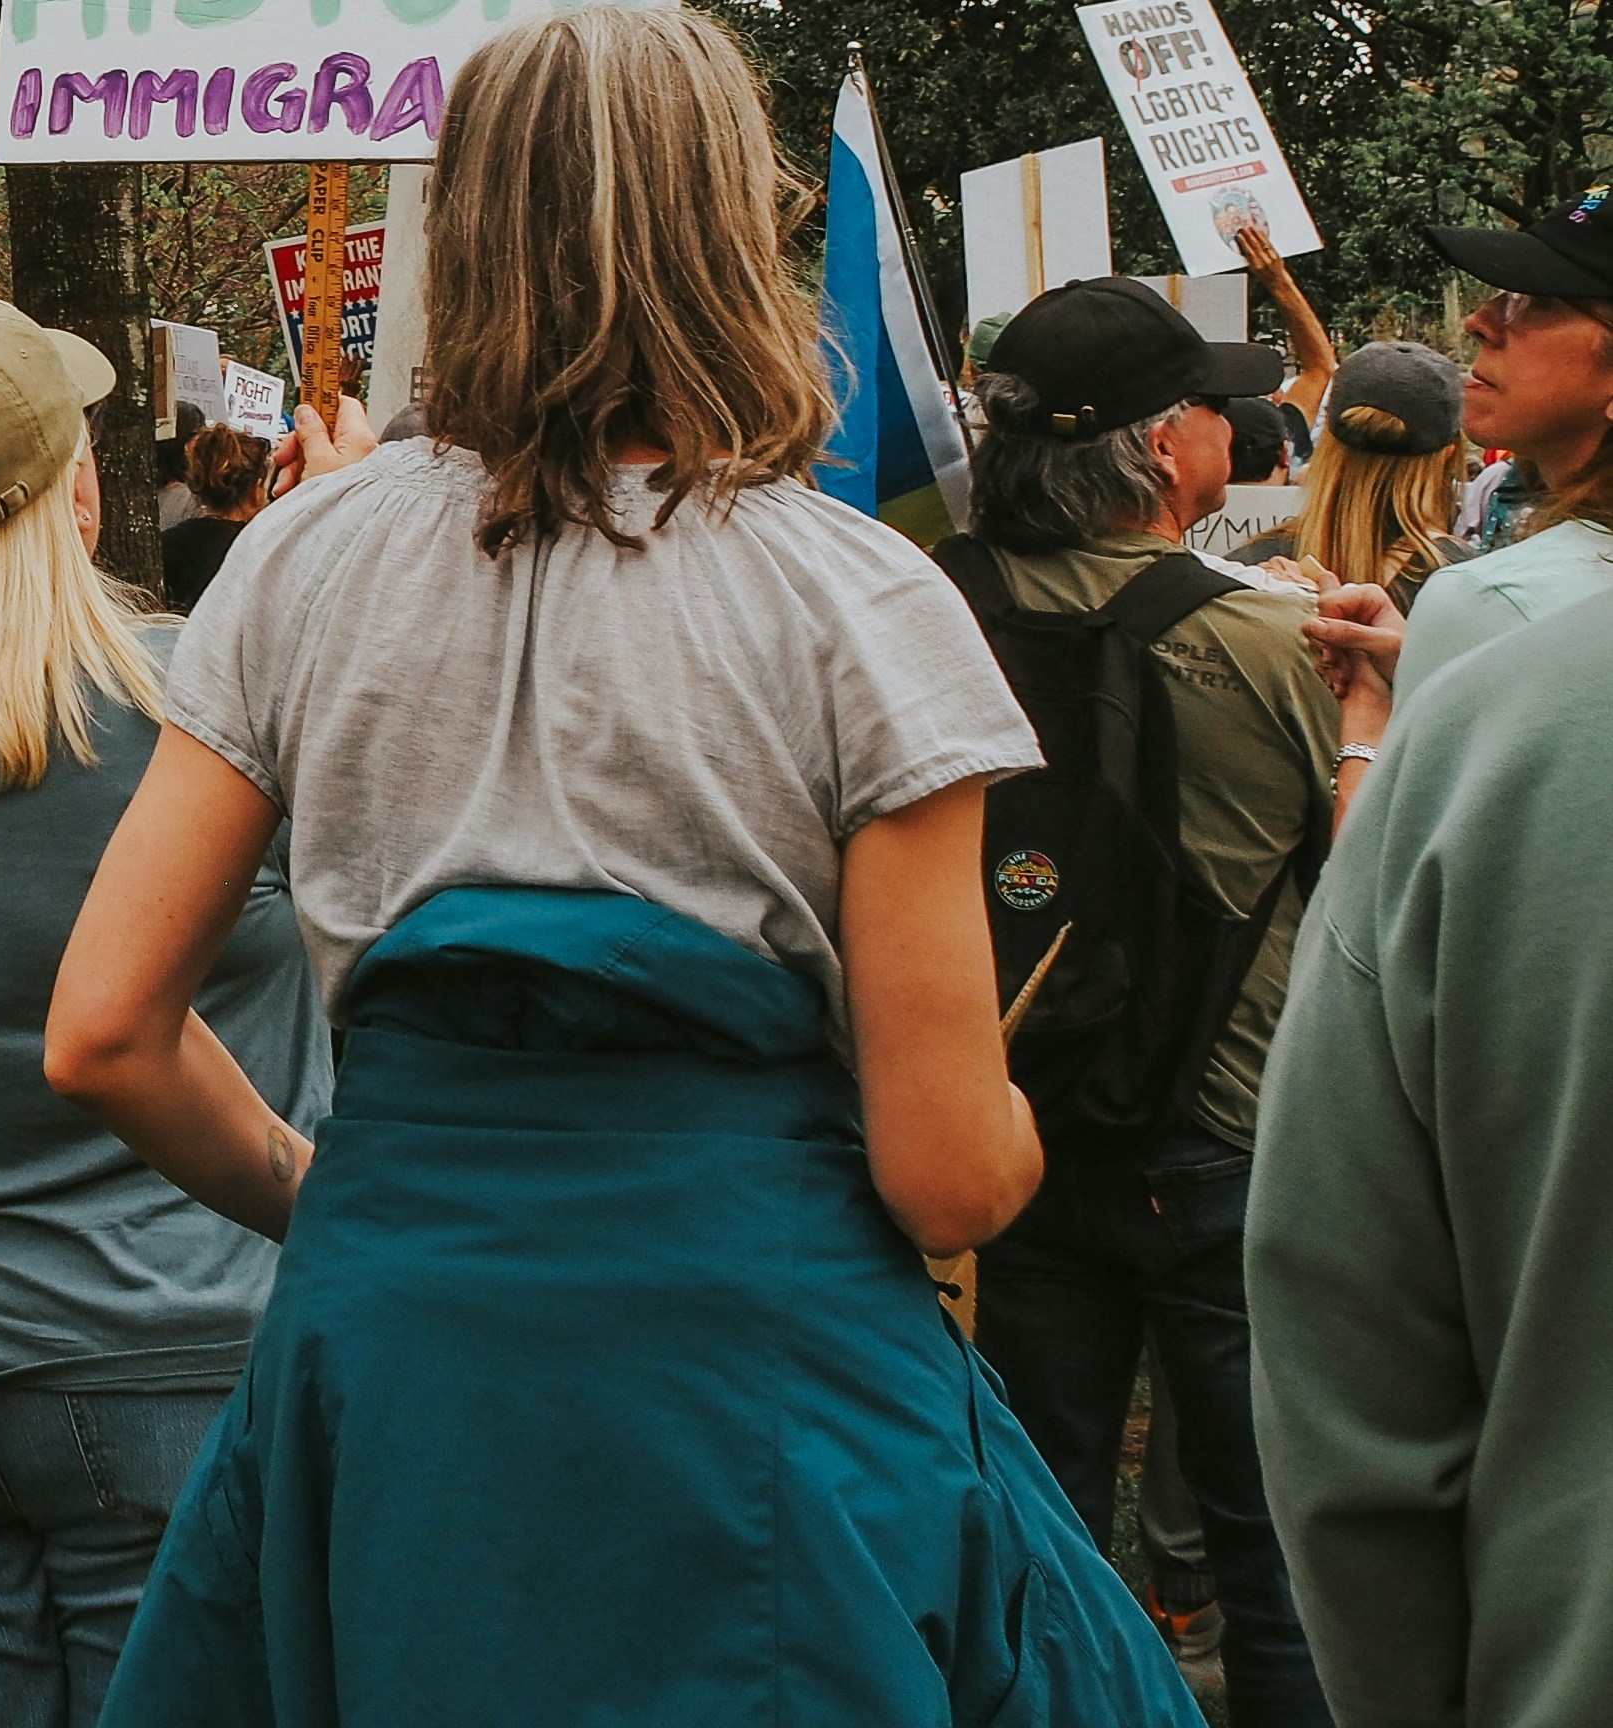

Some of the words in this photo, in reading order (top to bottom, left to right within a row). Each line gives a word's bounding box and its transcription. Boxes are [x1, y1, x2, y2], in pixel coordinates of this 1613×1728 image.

[1101, 1, 1194, 39] HANDS
[1118, 28, 1215, 82] OFF!
[1130, 80, 1236, 125] LGBTQ+
[1148, 117, 1260, 172] RIGHTS
[312, 162, 327, 215] PAPER
[310, 228, 325, 263] CLIP
[345, 236, 381, 263] THE
[235, 376, 272, 404] FIGHT
